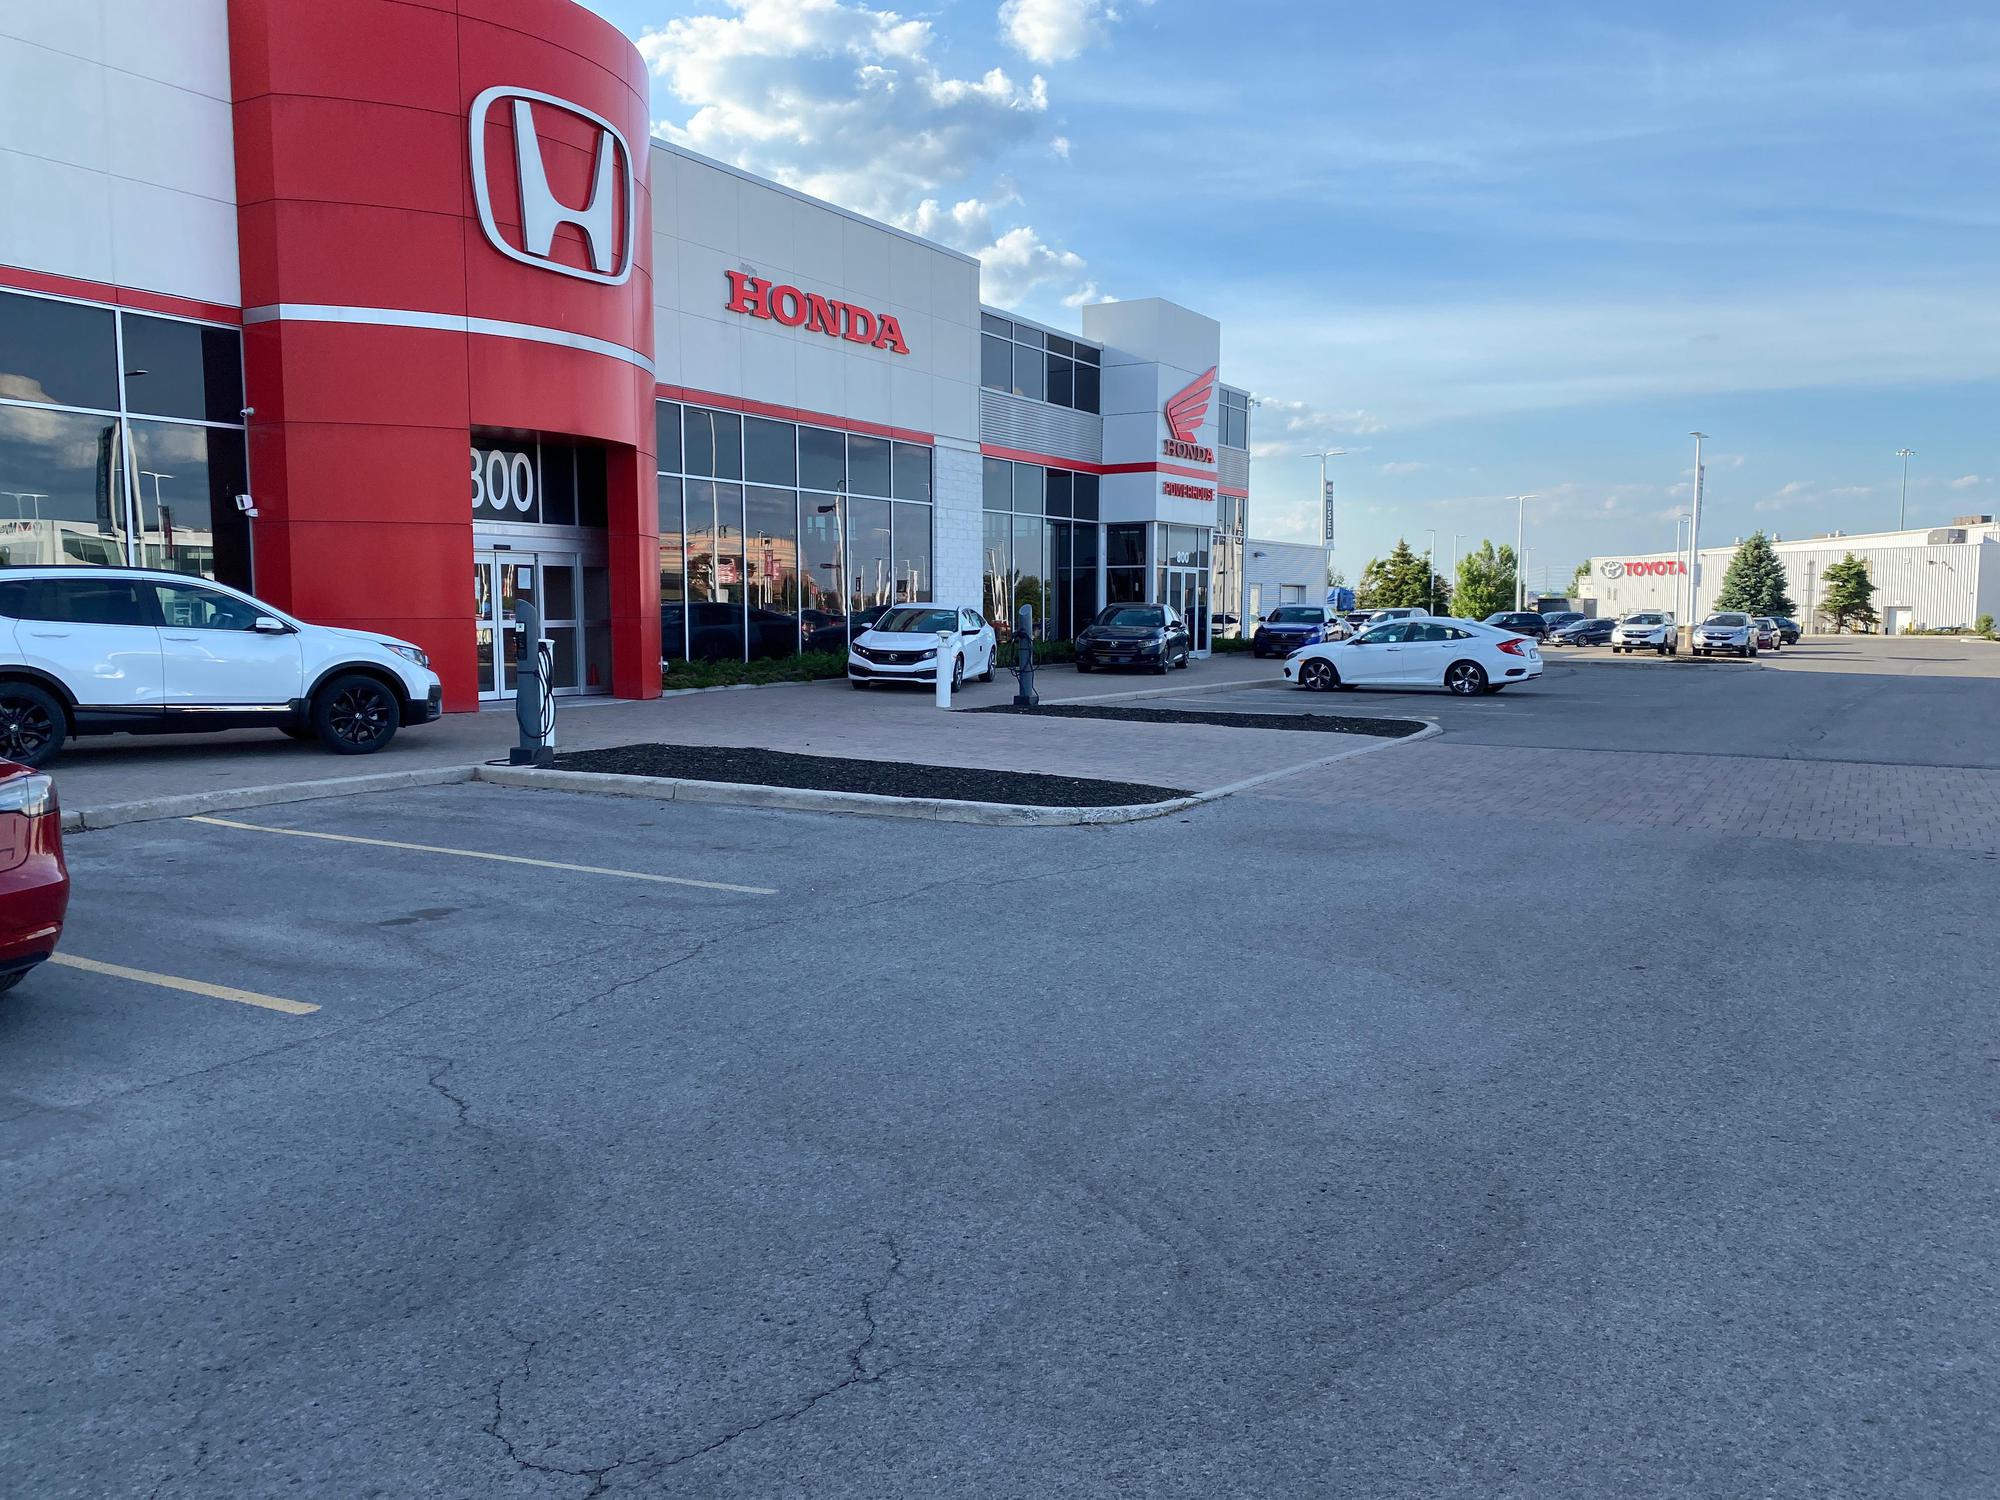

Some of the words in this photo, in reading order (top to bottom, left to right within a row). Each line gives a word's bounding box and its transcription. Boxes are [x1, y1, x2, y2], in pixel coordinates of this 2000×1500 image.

[724, 269, 910, 355] HONDA
[1163, 439, 1216, 464] HONDA
[1176, 551, 1190, 564] 800
[1624, 560, 1688, 577] TOYOTA
